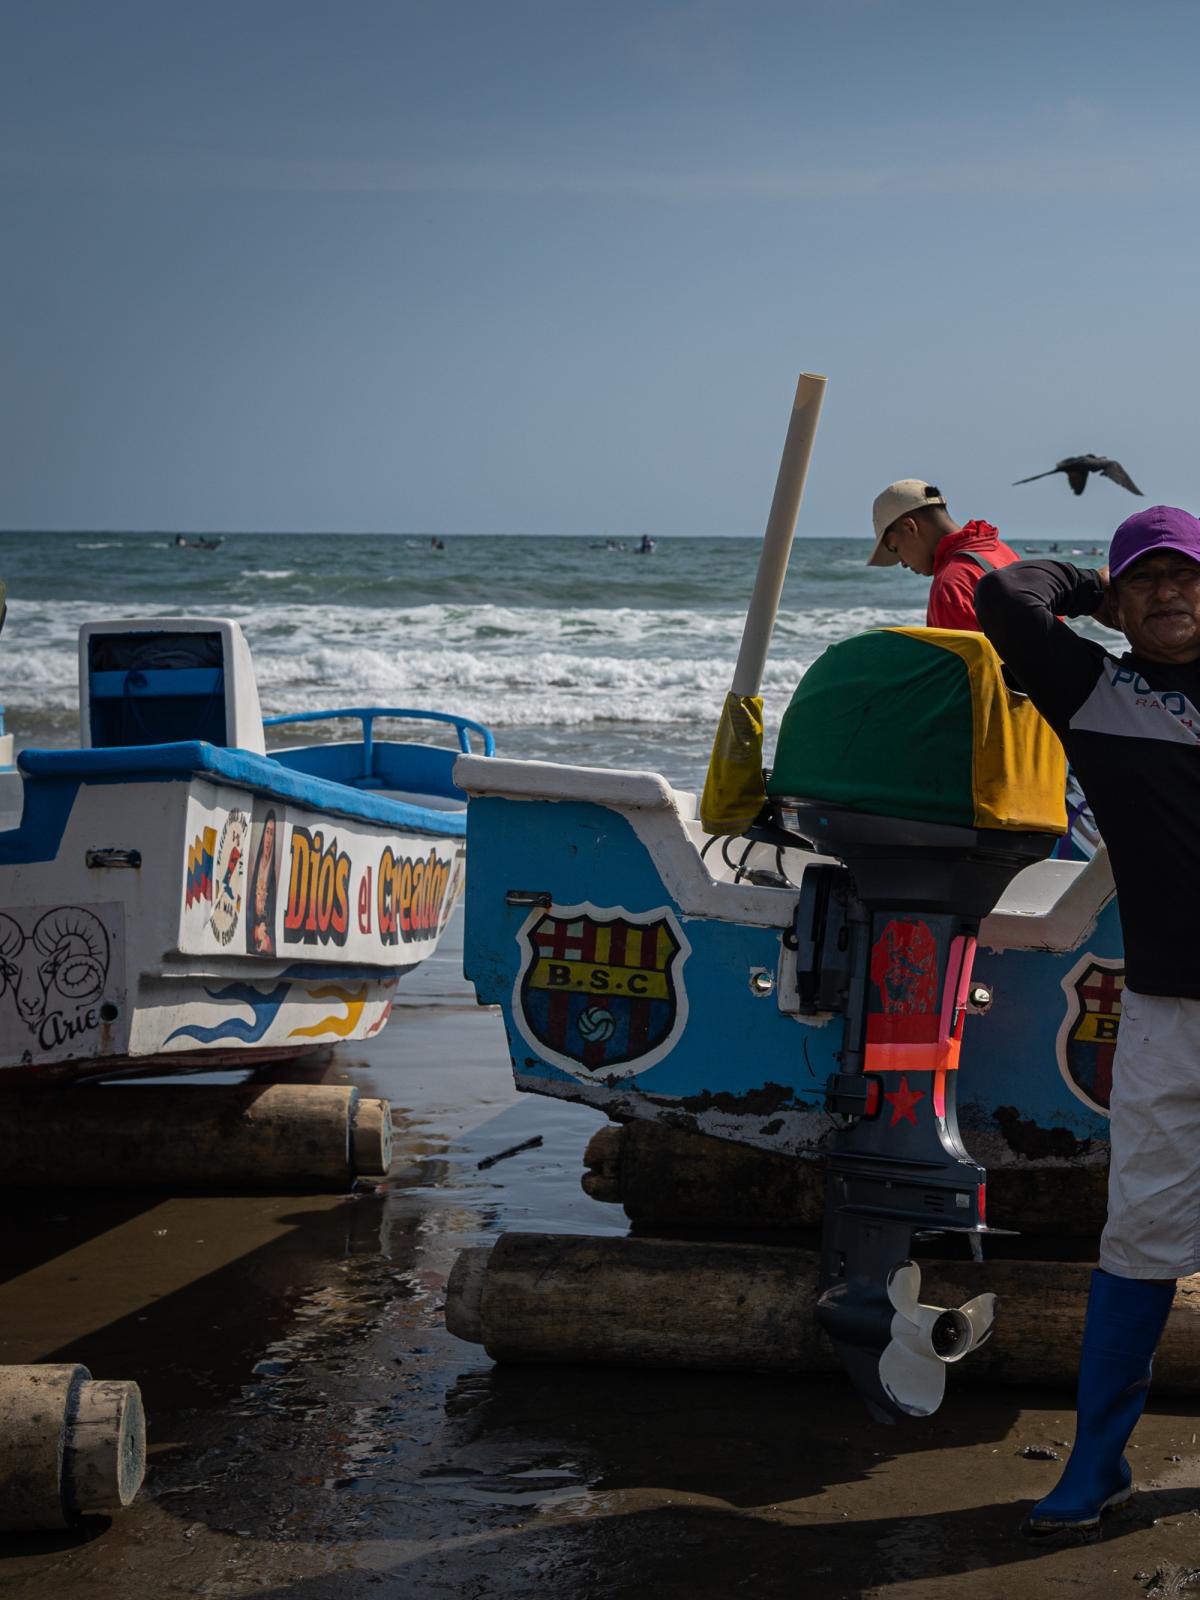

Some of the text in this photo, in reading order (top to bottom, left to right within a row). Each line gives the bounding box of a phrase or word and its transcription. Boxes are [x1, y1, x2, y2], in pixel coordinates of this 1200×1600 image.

[1112, 667, 1186, 715] POO
[358, 866, 371, 934] el
[378, 846, 450, 945] Creador
[547, 963, 649, 994] B.S.C
